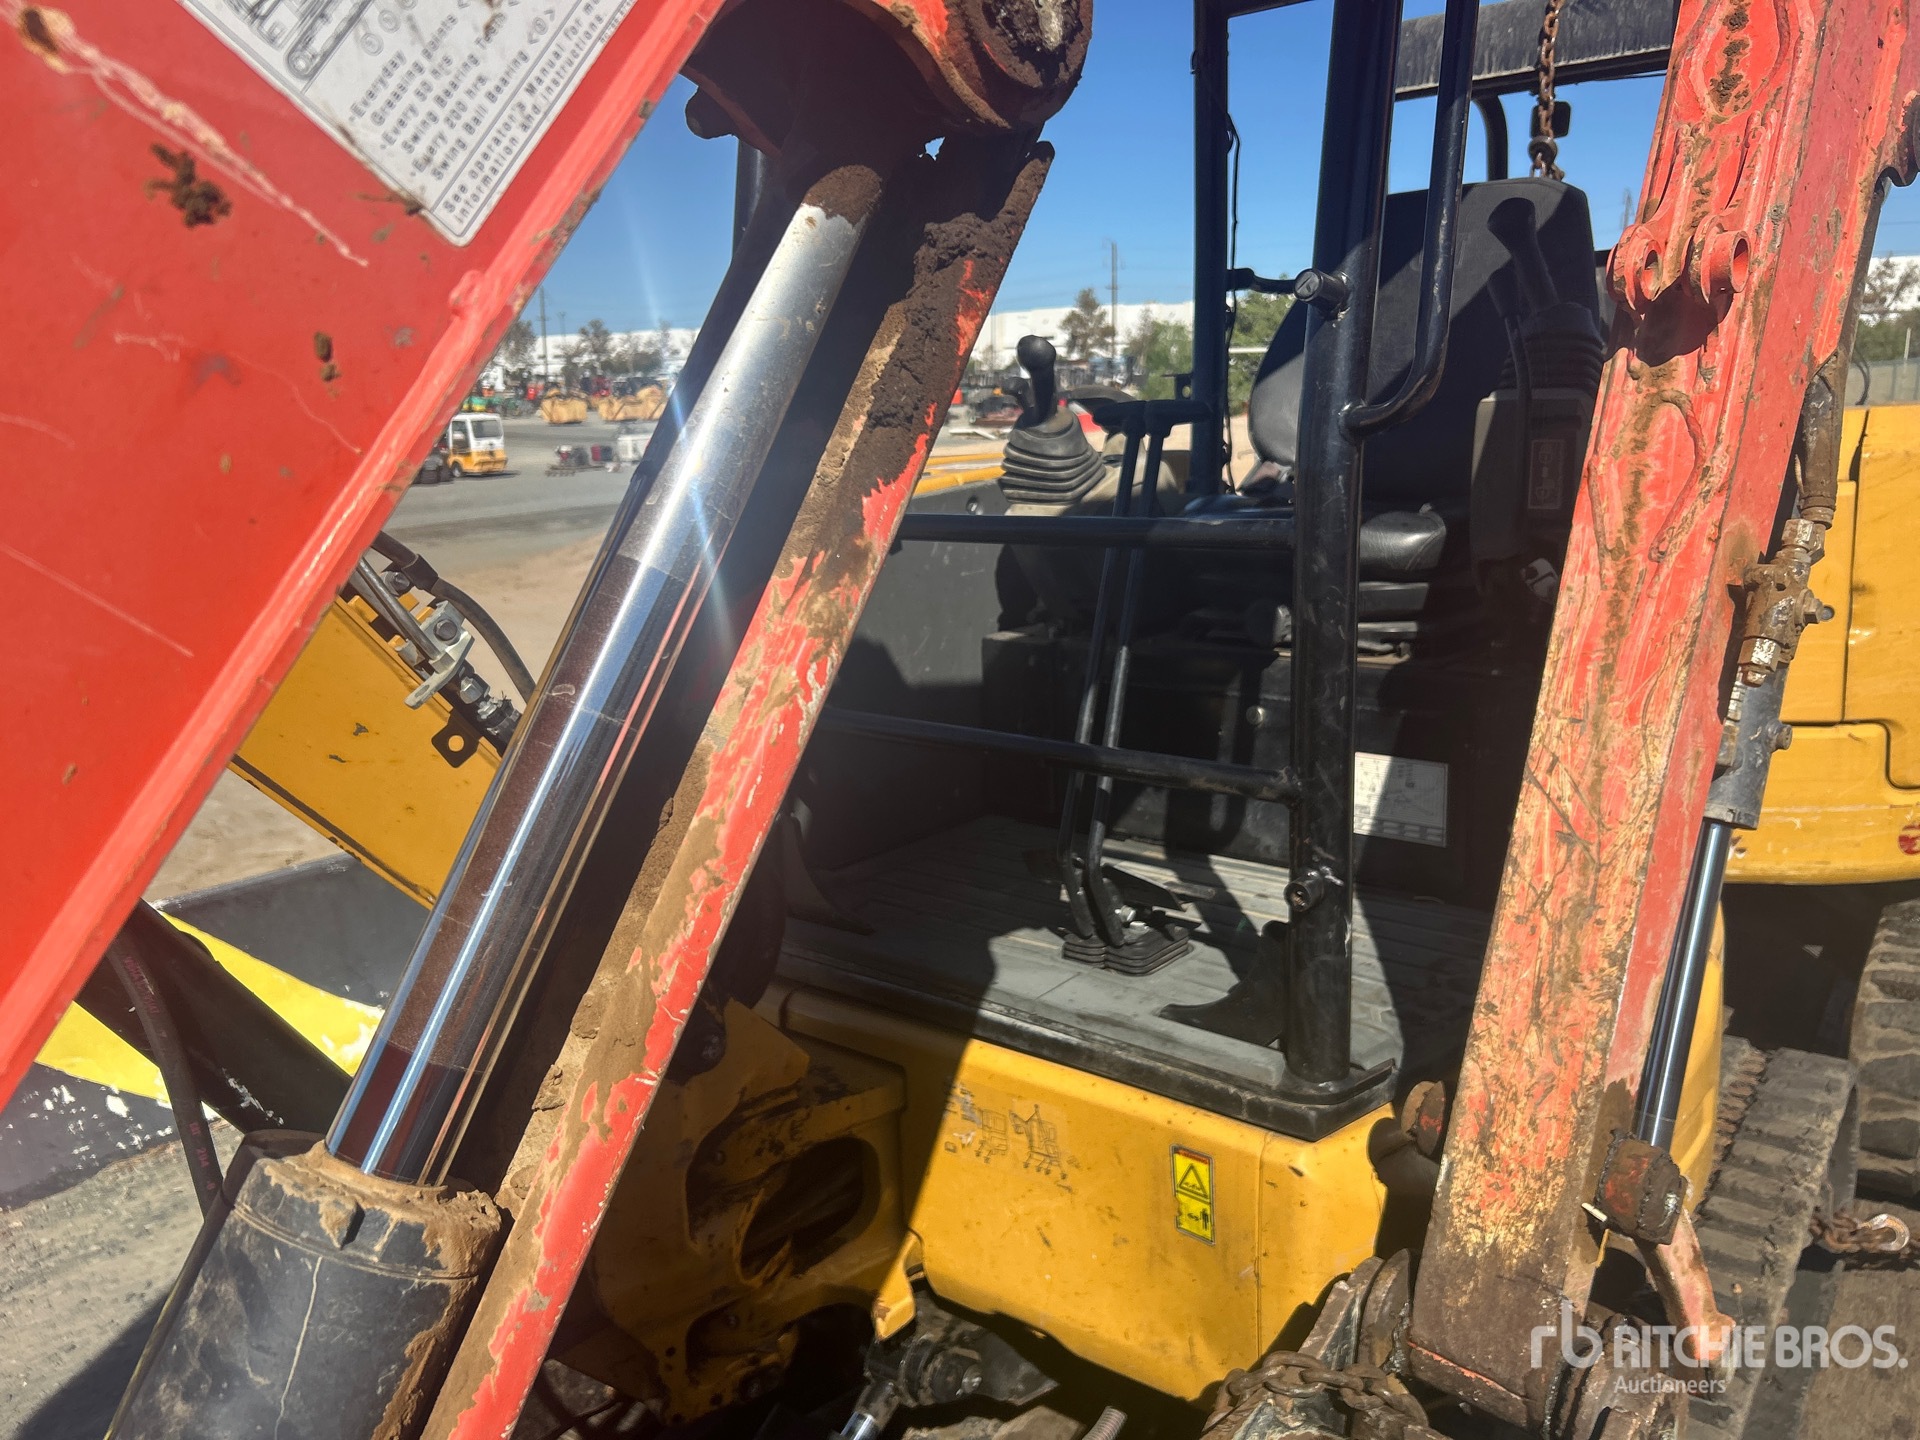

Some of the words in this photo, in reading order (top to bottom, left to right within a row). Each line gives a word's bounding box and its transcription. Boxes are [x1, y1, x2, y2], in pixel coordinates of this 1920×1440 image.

[370, 60, 426, 134] Greasing
[421, 14, 459, 62] points
[381, 103, 420, 146] Every
[401, 110, 440, 155] Swing
[433, 53, 480, 109] Bearing
[430, 137, 469, 181] Swing
[461, 104, 489, 136] Ball
[483, 49, 530, 105] Bearing
[442, 183, 469, 214] See
[467, 101, 527, 180] operator's
[523, 42, 565, 97] Manual
[562, 17, 584, 42] for
[411, 130, 448, 173] Every
[443, 100, 469, 130] 200
[453, 136, 519, 225] information
[518, 103, 542, 133] and
